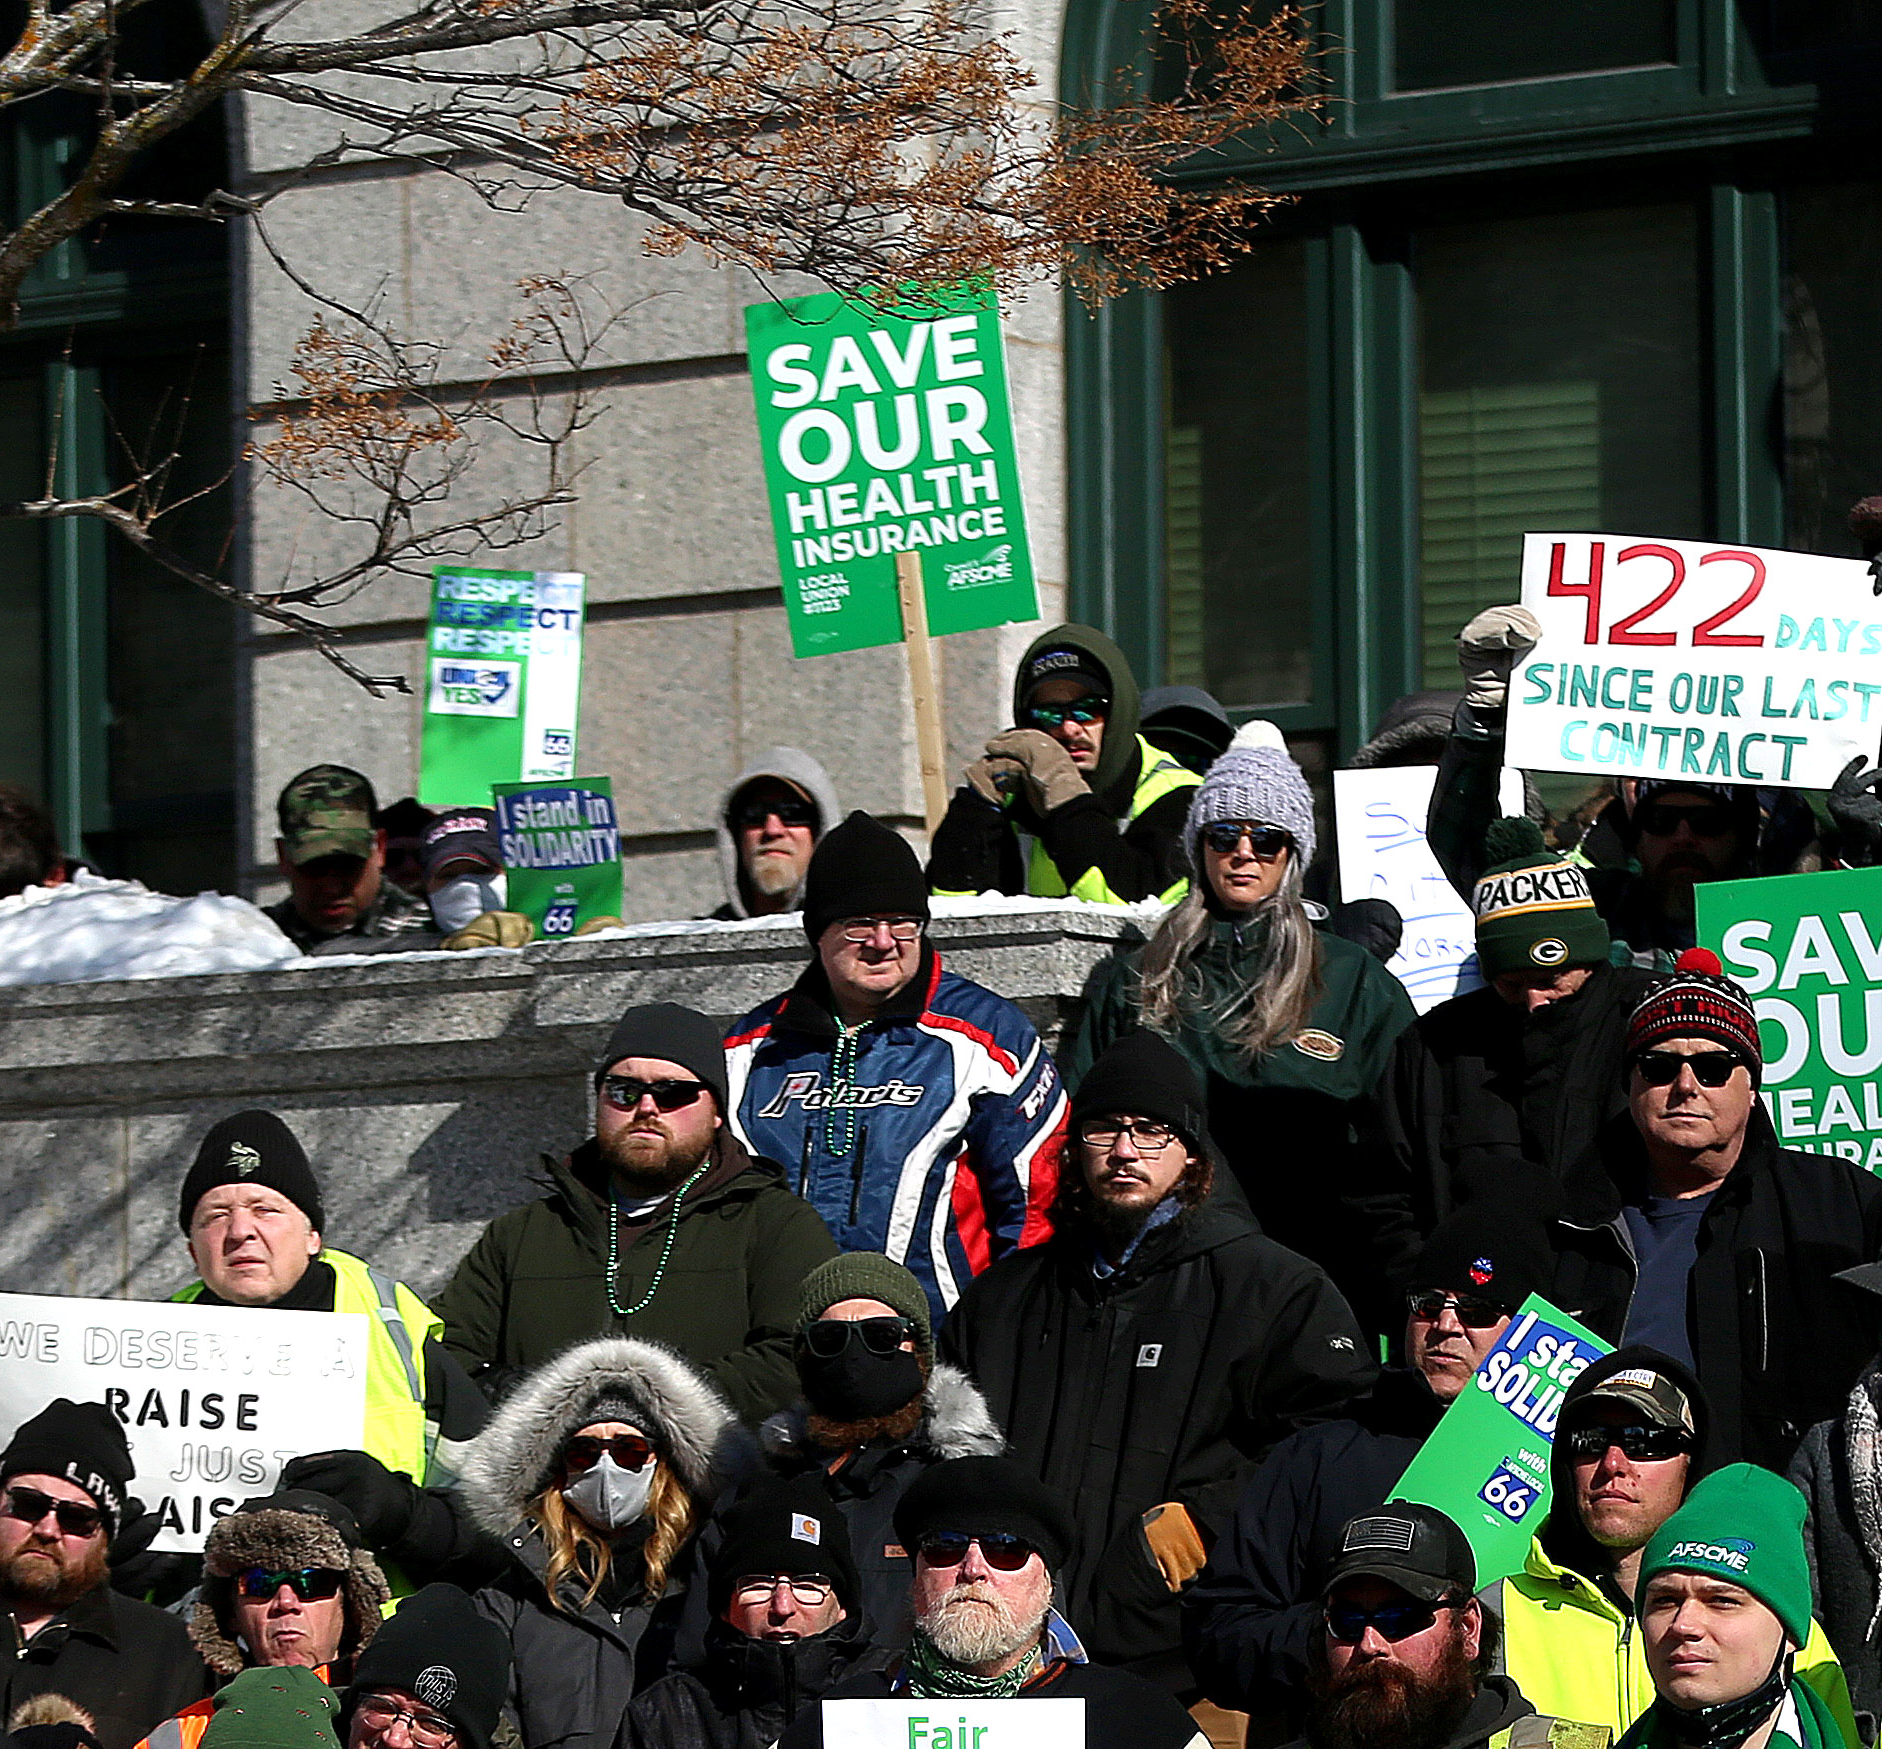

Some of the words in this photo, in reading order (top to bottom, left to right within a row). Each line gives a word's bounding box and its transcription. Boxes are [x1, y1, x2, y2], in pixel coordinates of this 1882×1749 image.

[767, 314, 984, 409] SAVE
[778, 384, 995, 483] OUR
[785, 459, 1000, 533] HEALTH
[792, 506, 1007, 568] INSURANCE
[436, 601, 580, 631] RESPECT
[1547, 541, 1767, 647] 422
[442, 686, 482, 705] YES
[1522, 663, 1654, 712] SINCE
[1669, 673, 1744, 717] OUR
[1762, 676, 1882, 722] LAST
[1560, 720, 1808, 781] CONTRACT
[496, 795, 510, 829] I
[513, 790, 581, 828] stand
[583, 789, 611, 825] in
[502, 828, 617, 868] SOLIDARITY
[543, 909, 574, 933] 66
[84, 1326, 292, 1376] DESERVE
[322, 1337, 355, 1378] A
[1506, 1310, 1538, 1350] I
[1529, 1334, 1590, 1388] sta
[106, 1387, 259, 1431] RAISE
[1477, 1350, 1566, 1439] SOLID
[1517, 1447, 1546, 1474] with
[1484, 1474, 1530, 1518] 66
[1668, 1542, 1749, 1572] AFSCME
[424, 1675, 447, 1693] THIS
[444, 1687, 456, 1699] IS
